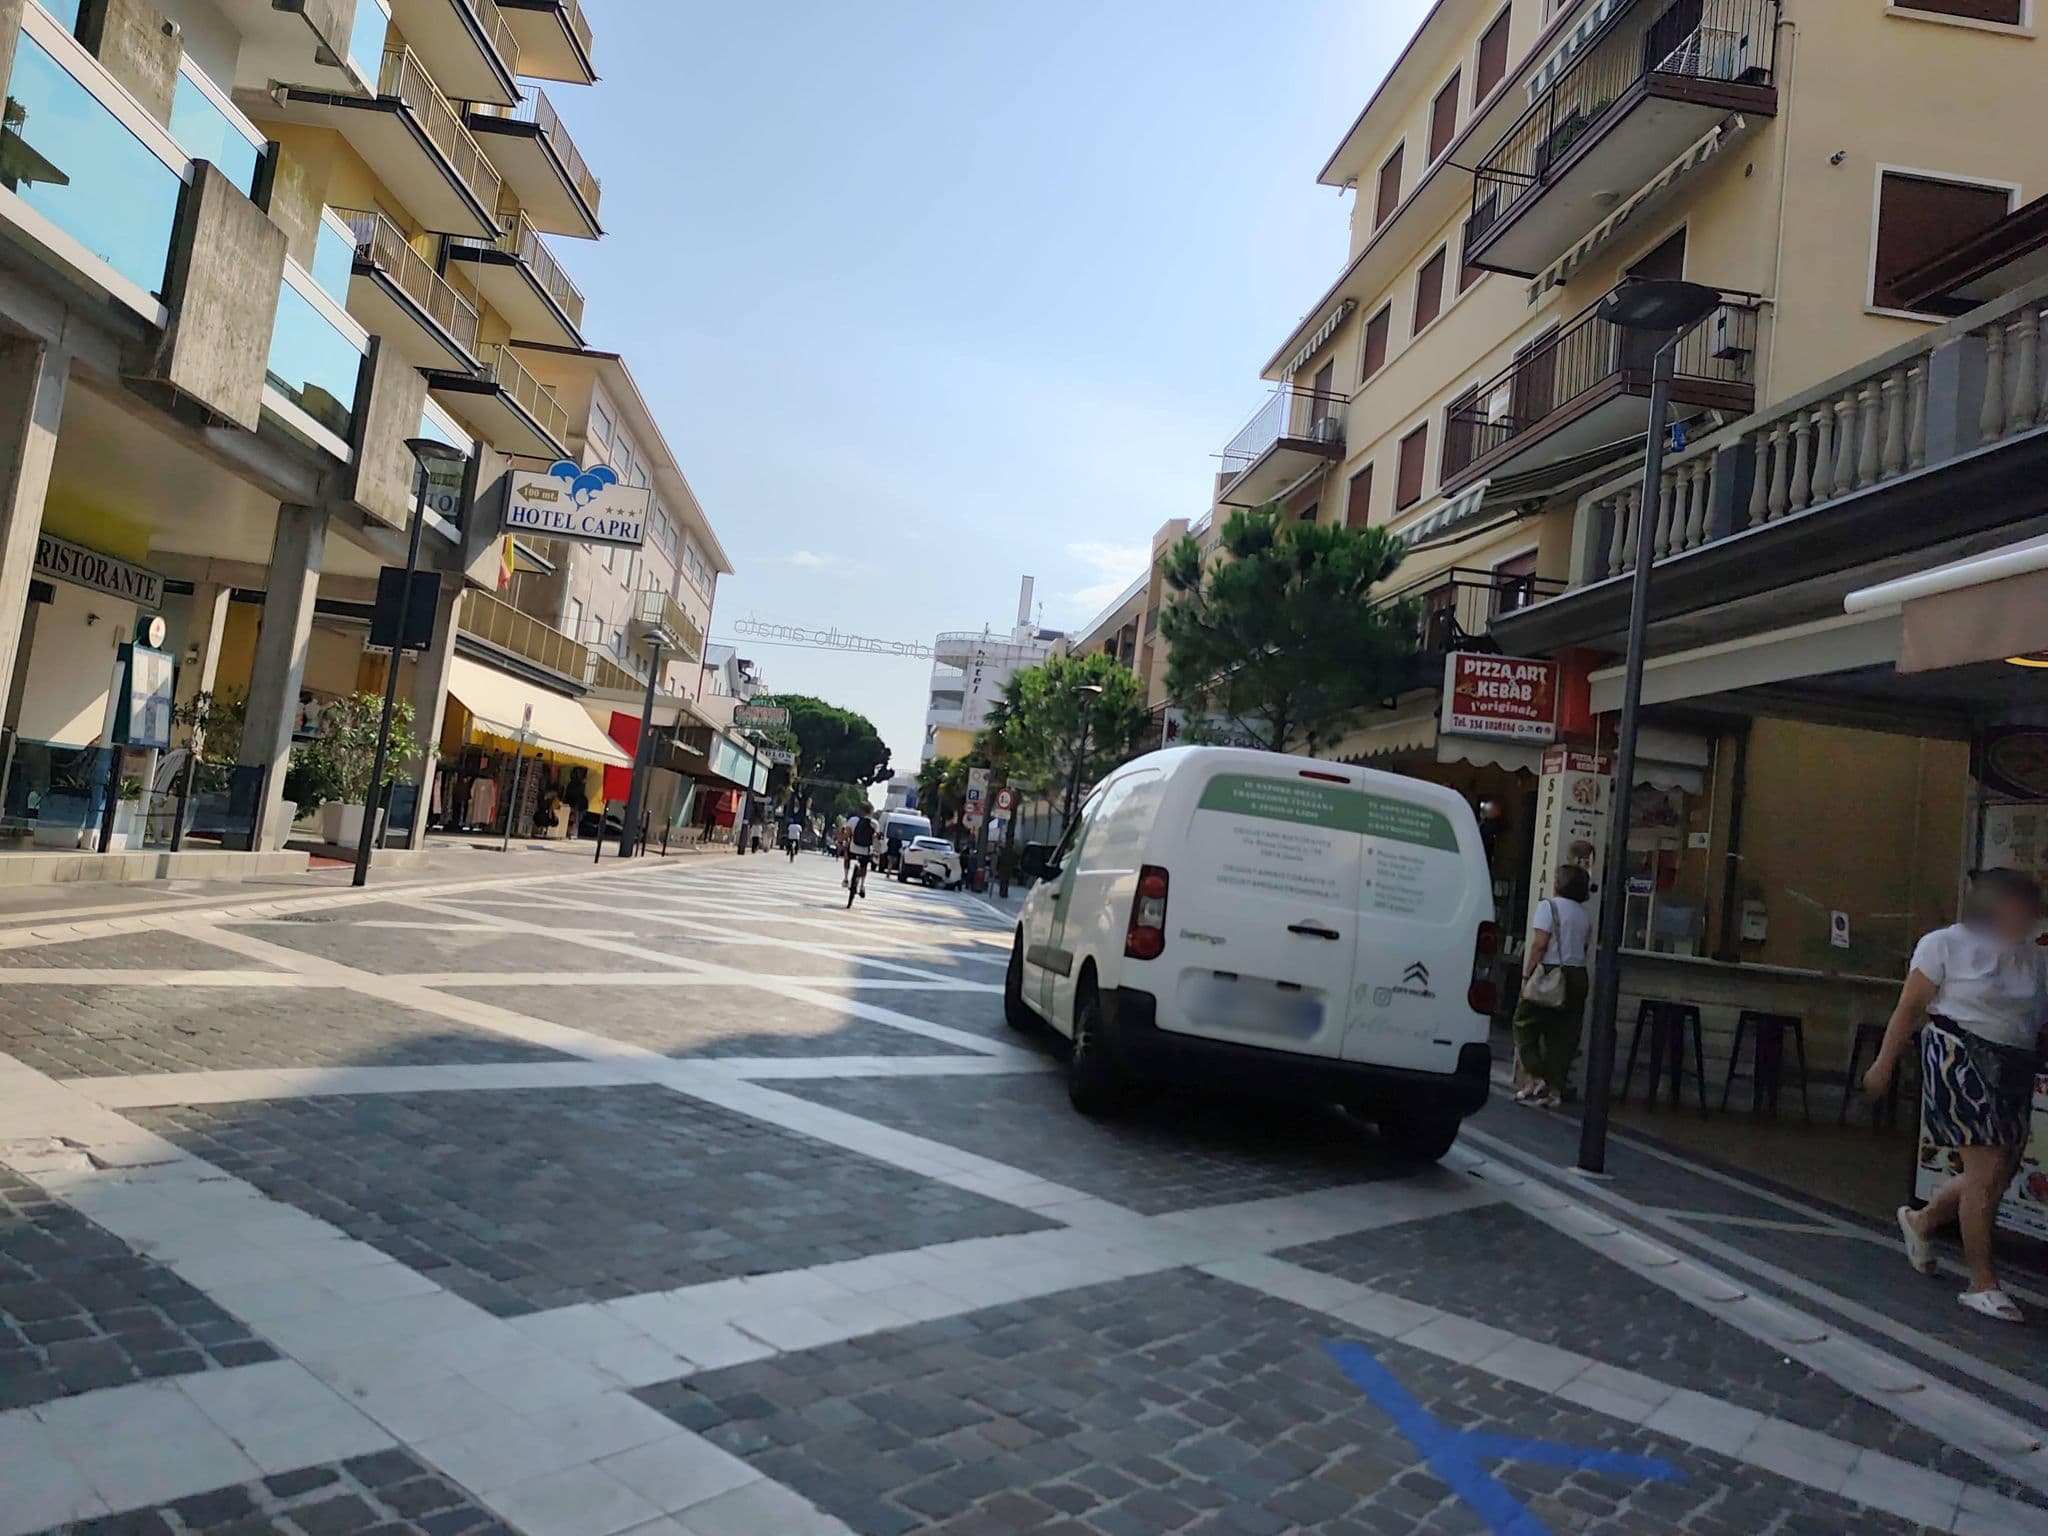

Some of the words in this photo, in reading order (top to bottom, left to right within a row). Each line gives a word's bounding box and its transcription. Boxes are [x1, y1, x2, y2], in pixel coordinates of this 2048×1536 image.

[522, 487, 540, 498] 100
[512, 506, 575, 530] HOTEL
[581, 516, 641, 539] CAPRI
[35, 540, 158, 603] RISTORANTE
[1463, 660, 1511, 680] PIZZA
[1516, 664, 1548, 685] ART
[1477, 681, 1532, 701] KEBAB
